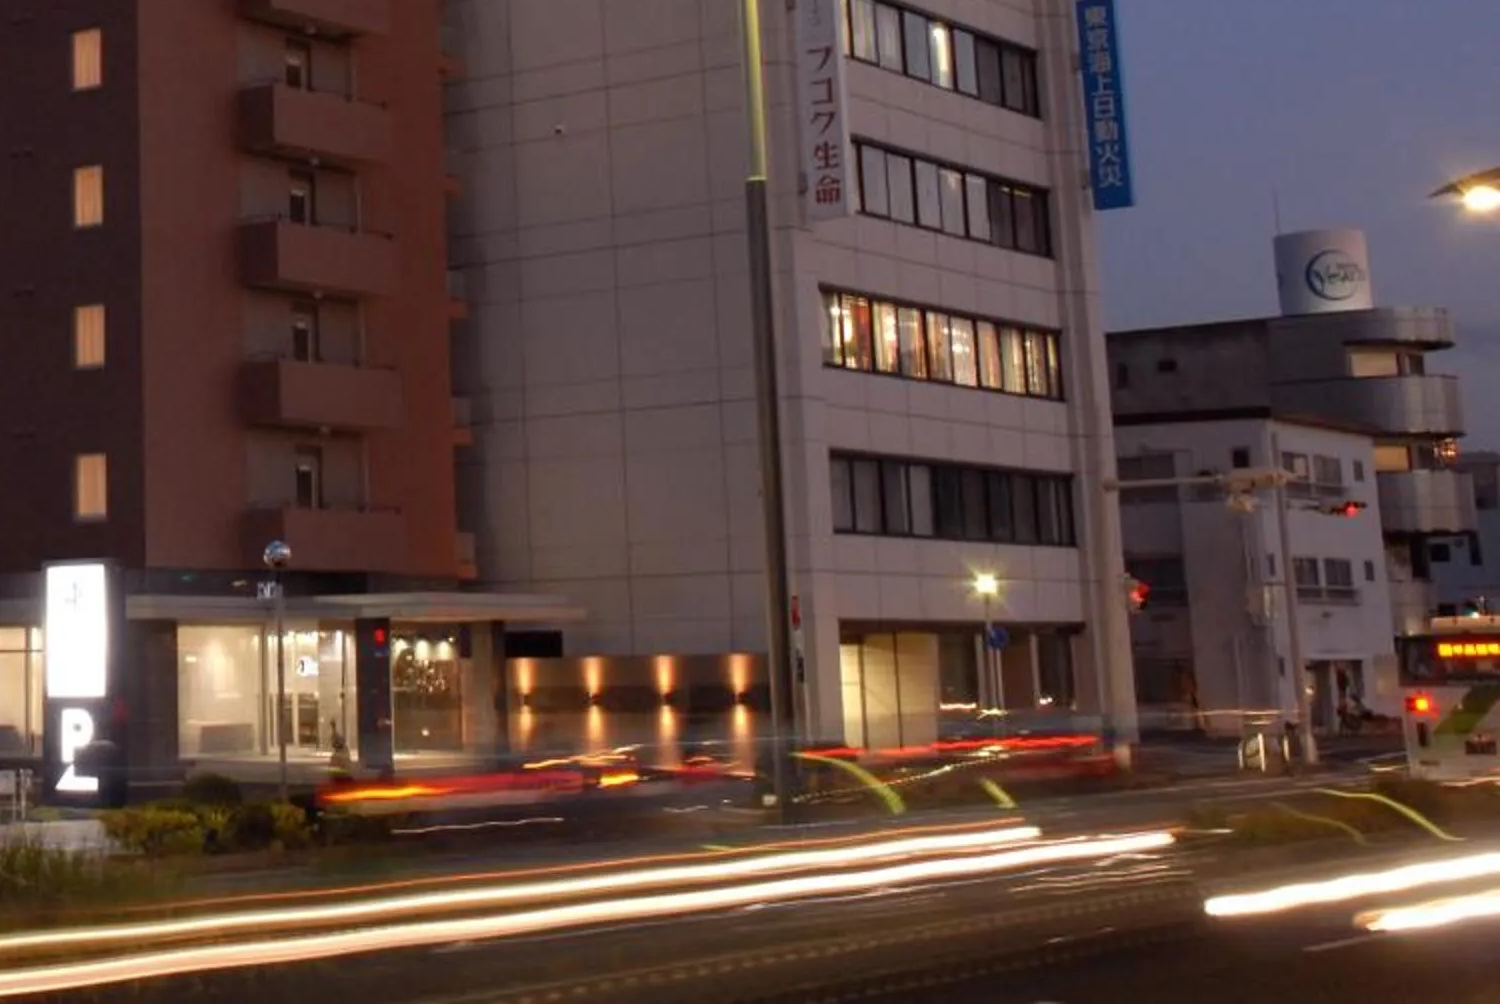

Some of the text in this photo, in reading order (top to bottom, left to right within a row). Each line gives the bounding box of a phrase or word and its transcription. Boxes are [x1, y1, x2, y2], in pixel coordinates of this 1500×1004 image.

[806, 44, 841, 205] フコク生命
[61, 707, 94, 763] P
